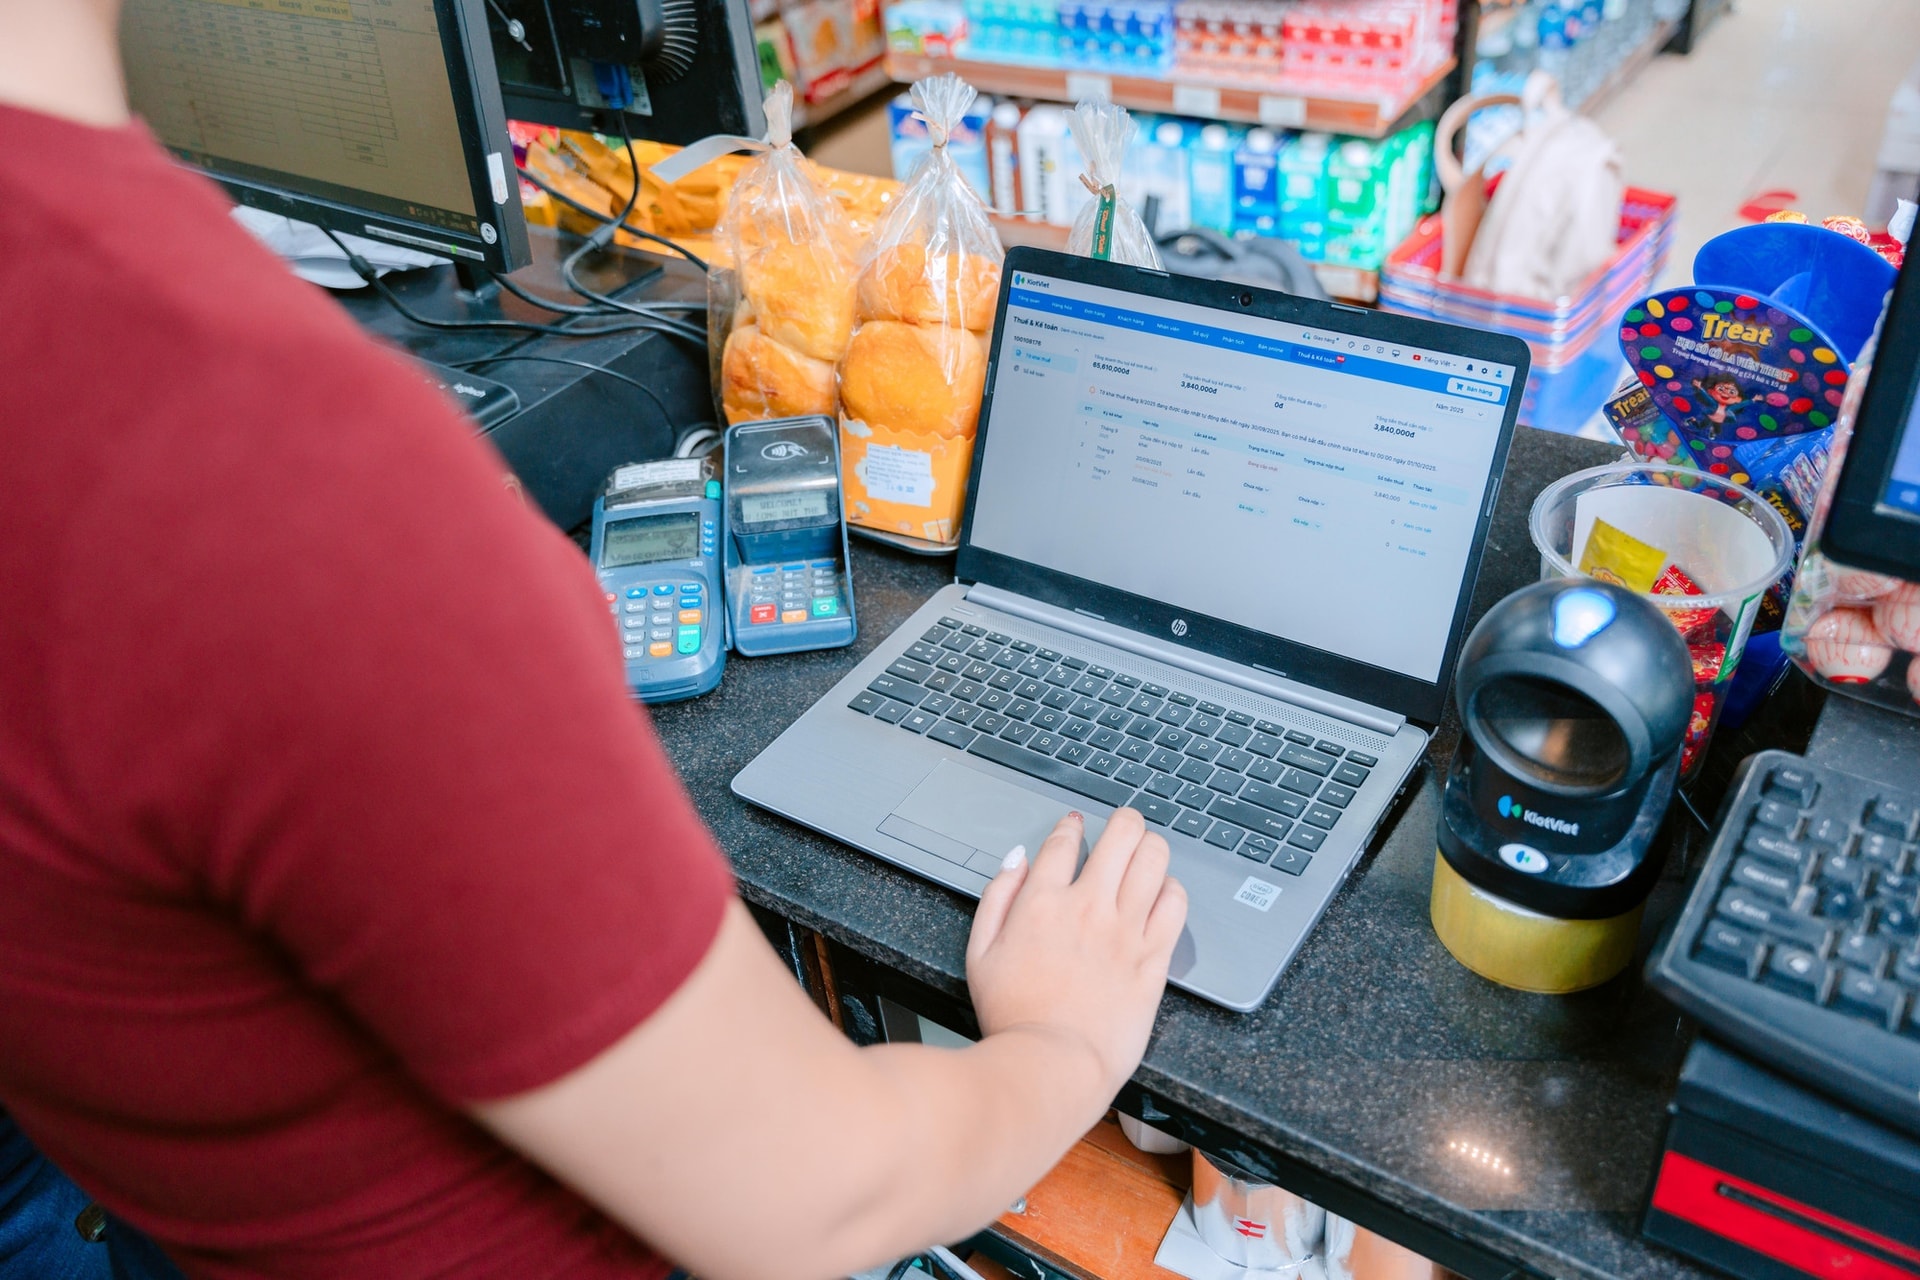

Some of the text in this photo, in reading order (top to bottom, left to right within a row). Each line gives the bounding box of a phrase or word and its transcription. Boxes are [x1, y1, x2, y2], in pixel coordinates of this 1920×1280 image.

[1027, 279, 1049, 288] KiotViet
[1013, 316, 1028, 325] Thuế
[1035, 320, 1044, 328] Kế
[1045, 323, 1058, 331] toán
[1133, 317, 1144, 326] hàng
[1702, 313, 1773, 346] Treat
[1297, 351, 1310, 359] Thuế
[1672, 347, 1690, 360] Trọng
[1424, 355, 1451, 367] Tiếng Việt
[1675, 335, 1793, 382] KẸO SÔ CÔ LA VIÊN TREAT
[1180, 381, 1217, 394] 3,840,000đ
[1478, 387, 1493, 397] hàng
[1274, 401, 1284, 409] 0đ
[1436, 403, 1464, 414] Năm 2025
[1373, 423, 1415, 438] 3,840,000đ
[1393, 457, 1406, 465] ngày
[1767, 491, 1802, 531] Treat
[1172, 619, 1187, 636] hp
[973, 665, 986, 674] W
[1000, 675, 1010, 683] E
[1026, 684, 1037, 692] R
[957, 708, 969, 716] X
[1044, 714, 1055, 722] G
[1071, 724, 1083, 732] H
[1040, 737, 1051, 745] B
[1168, 733, 1179, 741] O
[1068, 748, 1080, 756] N
[1128, 744, 1140, 752] K
[1097, 758, 1109, 767] M
[1159, 755, 1167, 763] L
[1301, 754, 1327, 765] backspace
[1343, 769, 1358, 777] home
[1523, 809, 1580, 836] KiotViet
